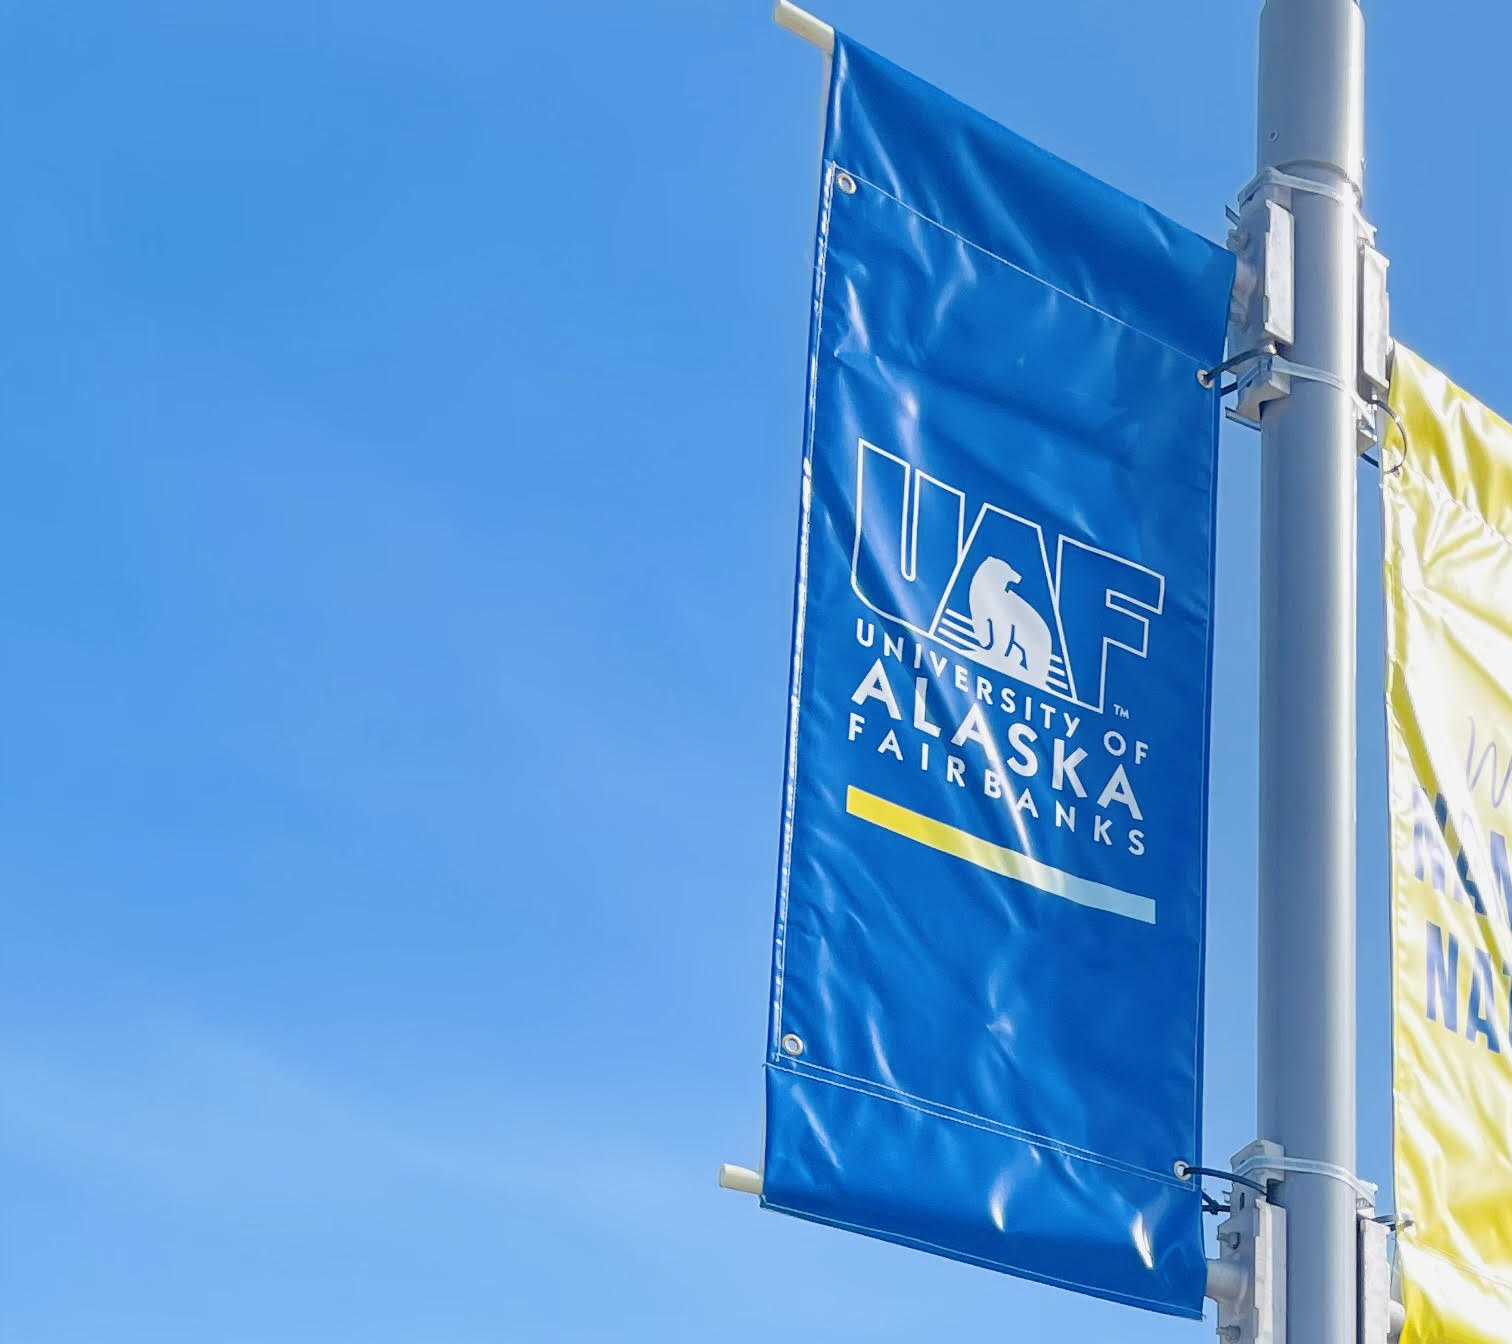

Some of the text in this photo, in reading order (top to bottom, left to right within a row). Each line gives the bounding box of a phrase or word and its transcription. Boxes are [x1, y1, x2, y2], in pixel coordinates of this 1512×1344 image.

[851, 438, 1165, 714] UAF
[851, 658, 1143, 822] ALASKA
[855, 618, 1149, 765] UNIVERSITY OF
[848, 712, 1145, 857] FAIRBANKS
